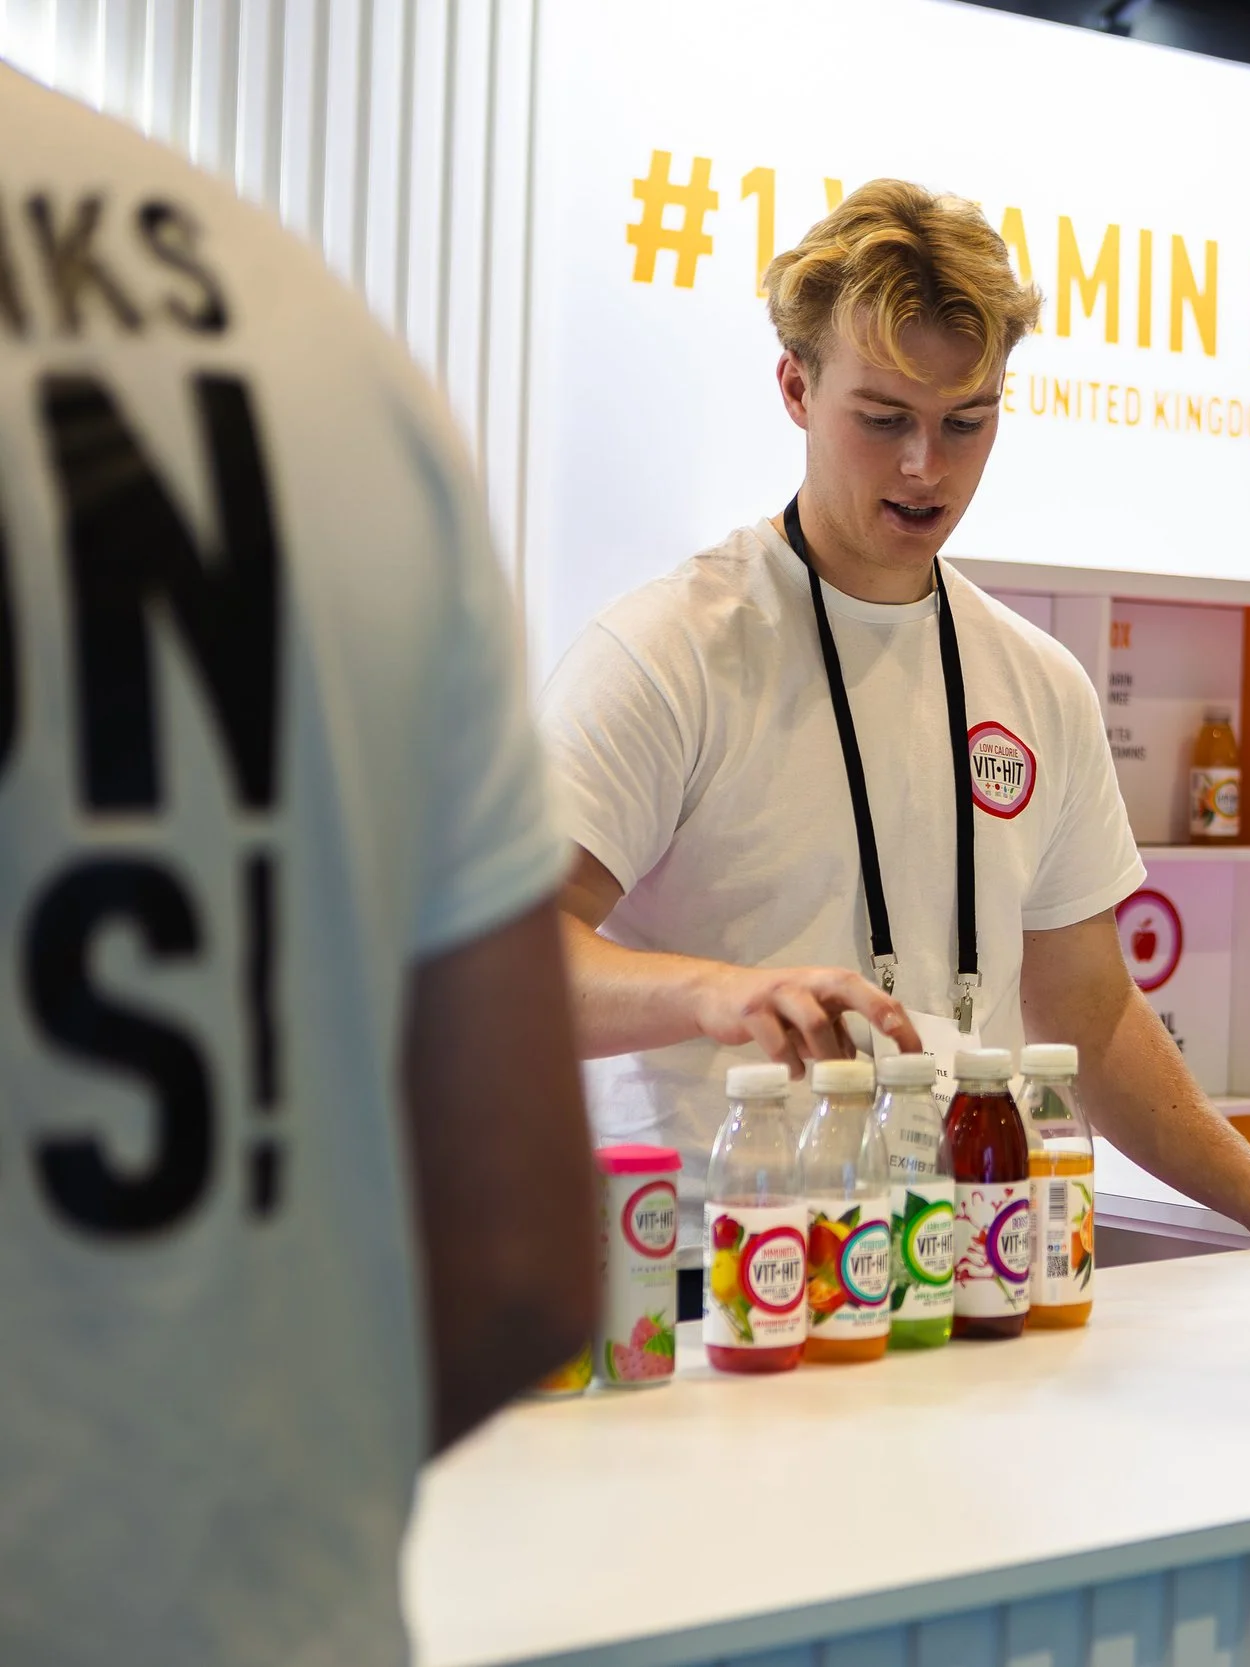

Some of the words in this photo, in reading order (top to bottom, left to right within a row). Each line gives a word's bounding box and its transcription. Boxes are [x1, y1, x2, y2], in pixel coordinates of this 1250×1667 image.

[625, 148, 776, 298] #1
[1030, 374, 1142, 427] UNITED
[0, 364, 285, 820] N
[979, 742, 994, 753] LOW
[994, 745, 1019, 759] CALORIE
